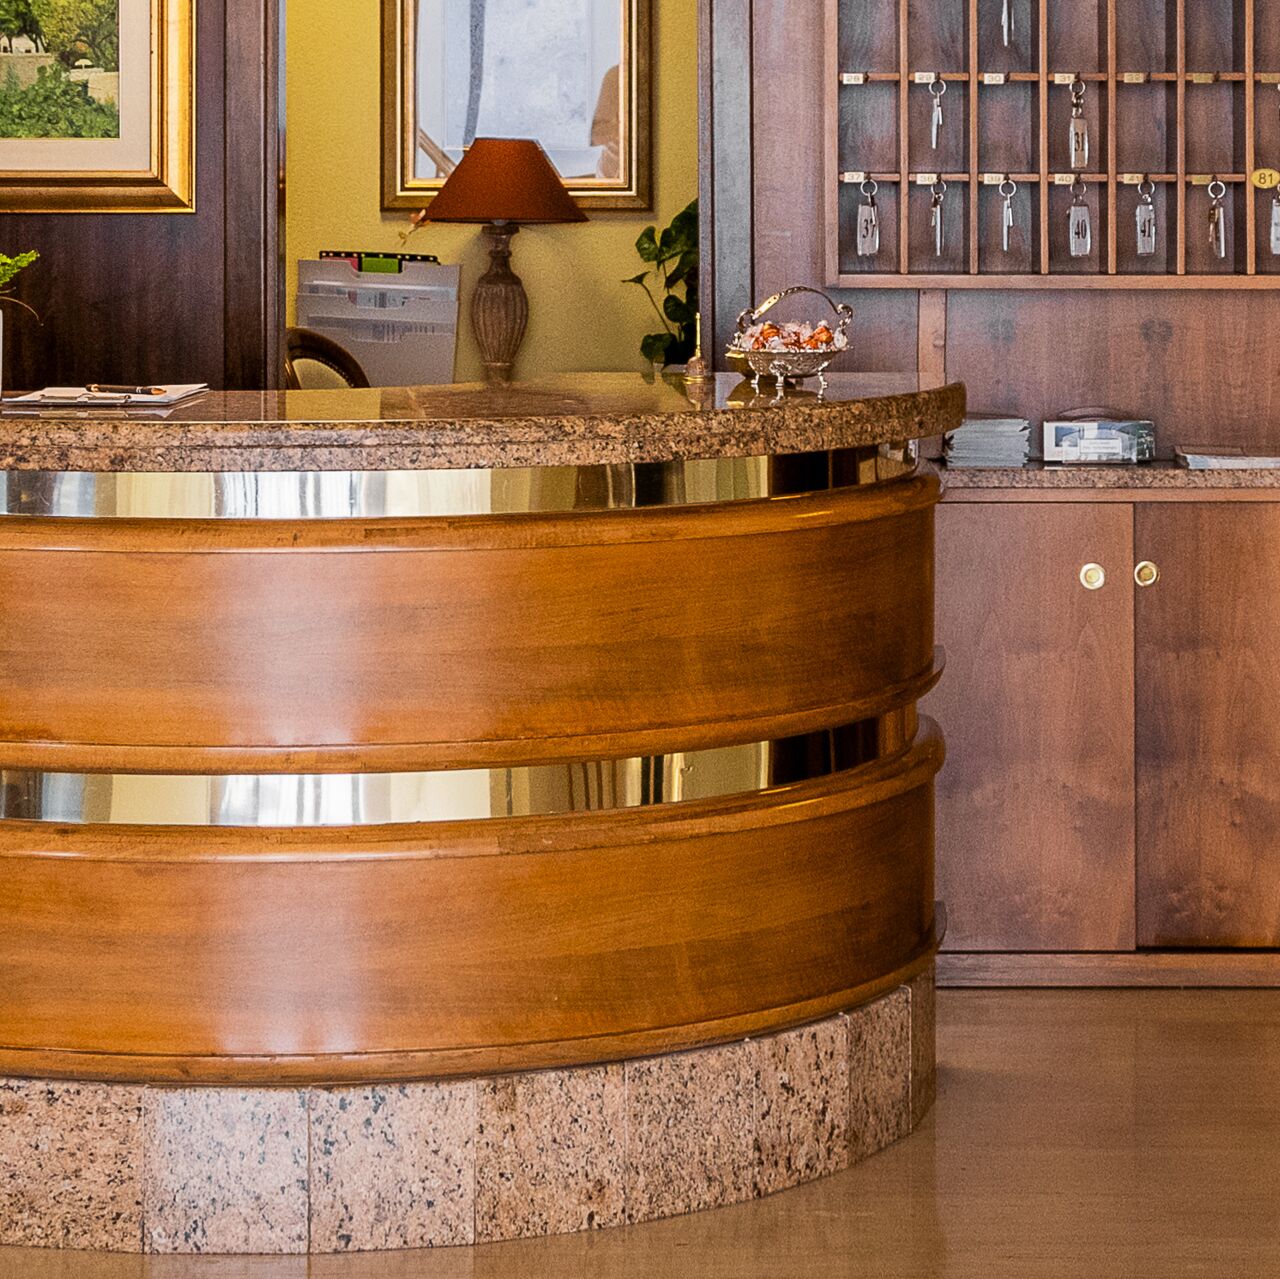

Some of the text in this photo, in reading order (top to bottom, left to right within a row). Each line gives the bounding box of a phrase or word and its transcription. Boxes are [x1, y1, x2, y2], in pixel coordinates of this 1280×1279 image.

[1074, 132, 1084, 152] 31
[1258, 172, 1274, 184] 81
[1074, 220, 1087, 239] 40
[1140, 218, 1151, 238] 41
